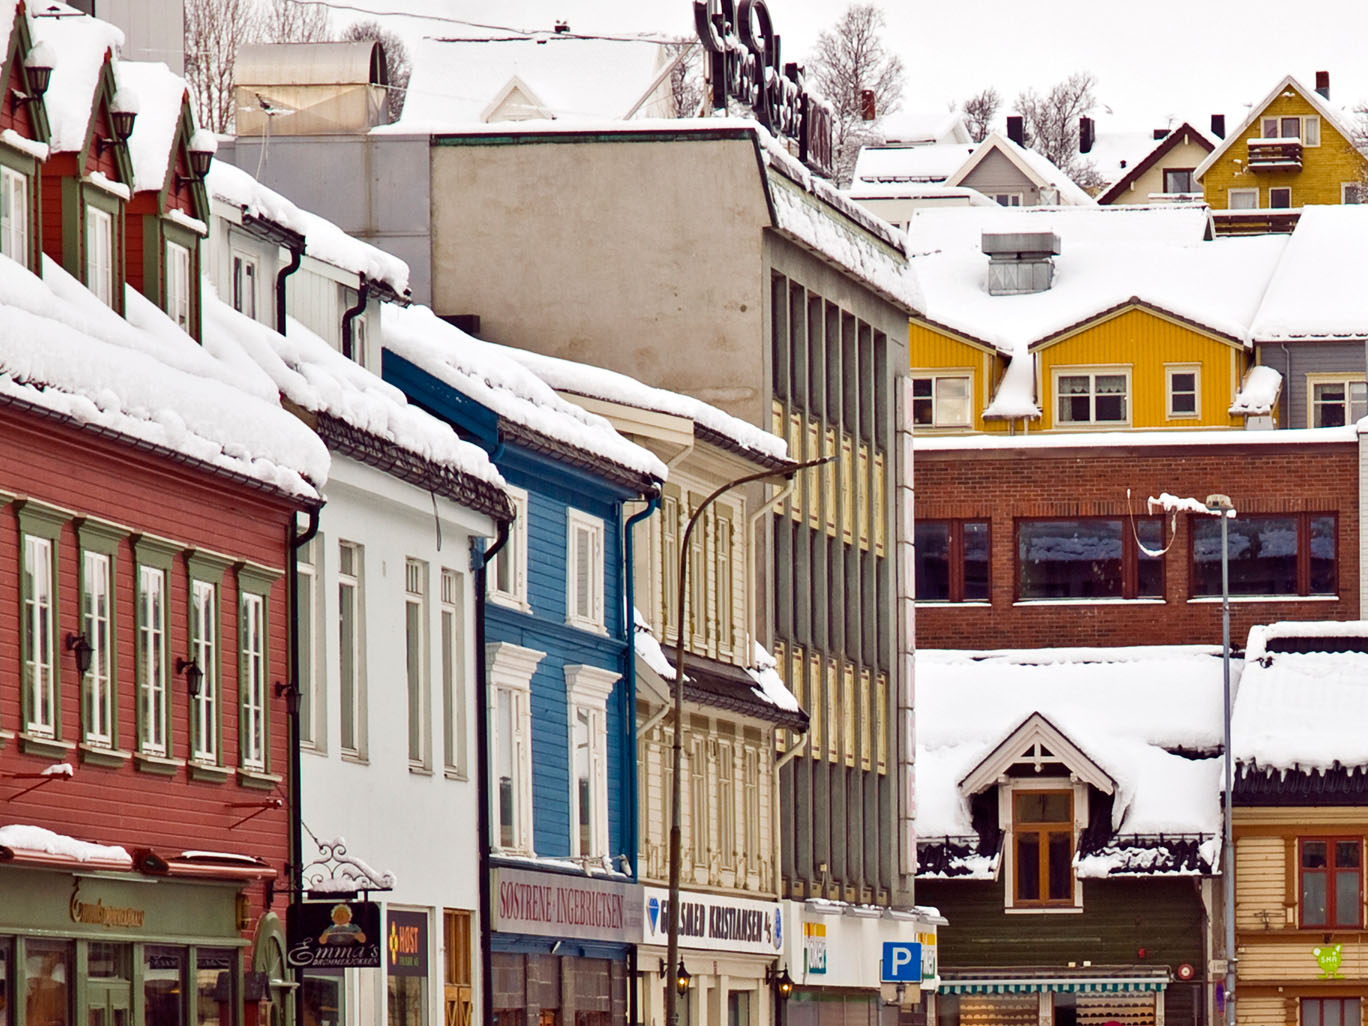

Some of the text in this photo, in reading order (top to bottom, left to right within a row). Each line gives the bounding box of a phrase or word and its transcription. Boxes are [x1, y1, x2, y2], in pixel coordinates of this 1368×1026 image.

[500, 881, 552, 922] SØSTRENE
[556, 887, 624, 929] INGEBRIGTSEN
[660, 899, 706, 938] GSMED
[708, 904, 763, 943] KRISTIANSEN
[891, 946, 912, 976] P
